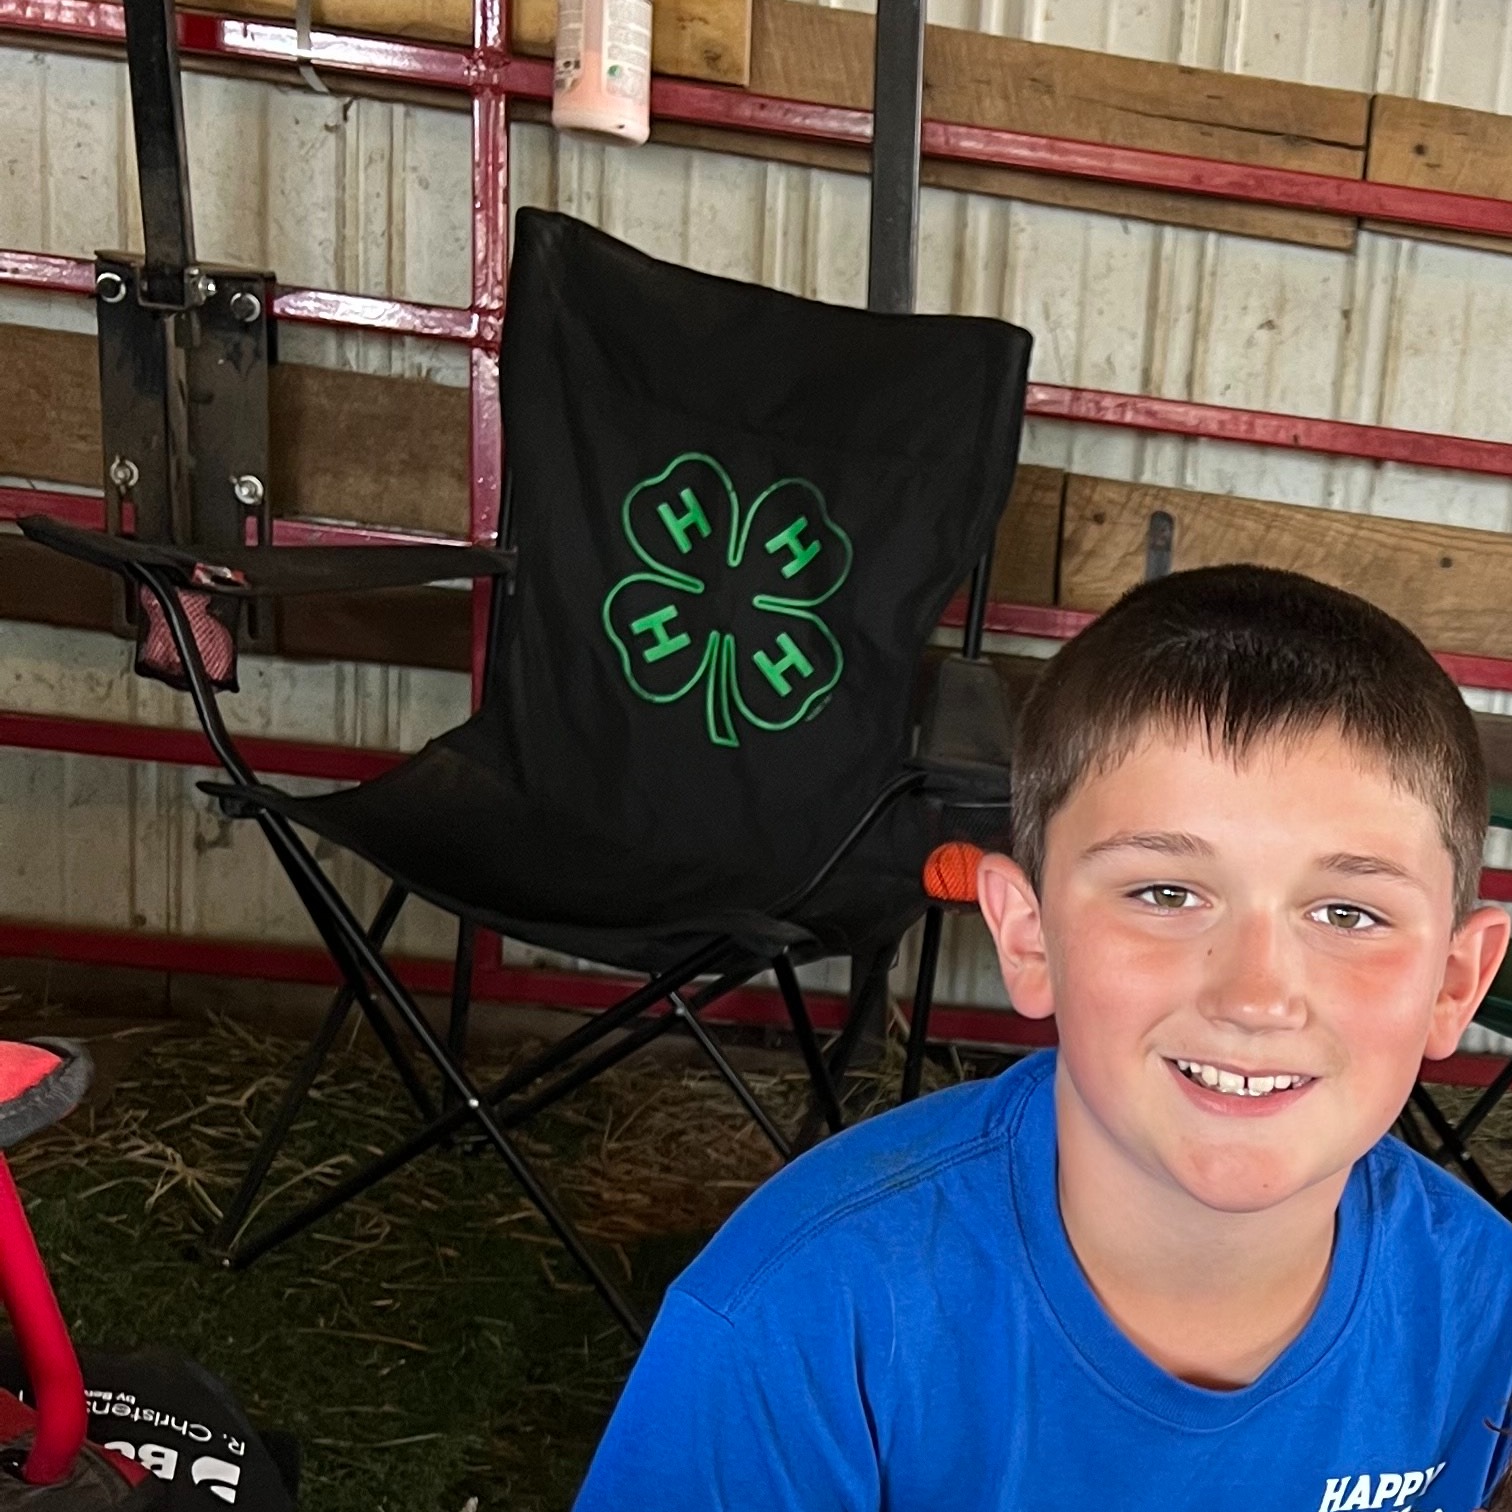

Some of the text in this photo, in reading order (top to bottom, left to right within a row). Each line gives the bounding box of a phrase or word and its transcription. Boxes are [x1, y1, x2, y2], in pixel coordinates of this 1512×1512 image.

[657, 487, 712, 554] H
[764, 515, 822, 580] H
[630, 604, 692, 664] H
[753, 632, 815, 698] H
[223, 1433, 245, 1456] R.
